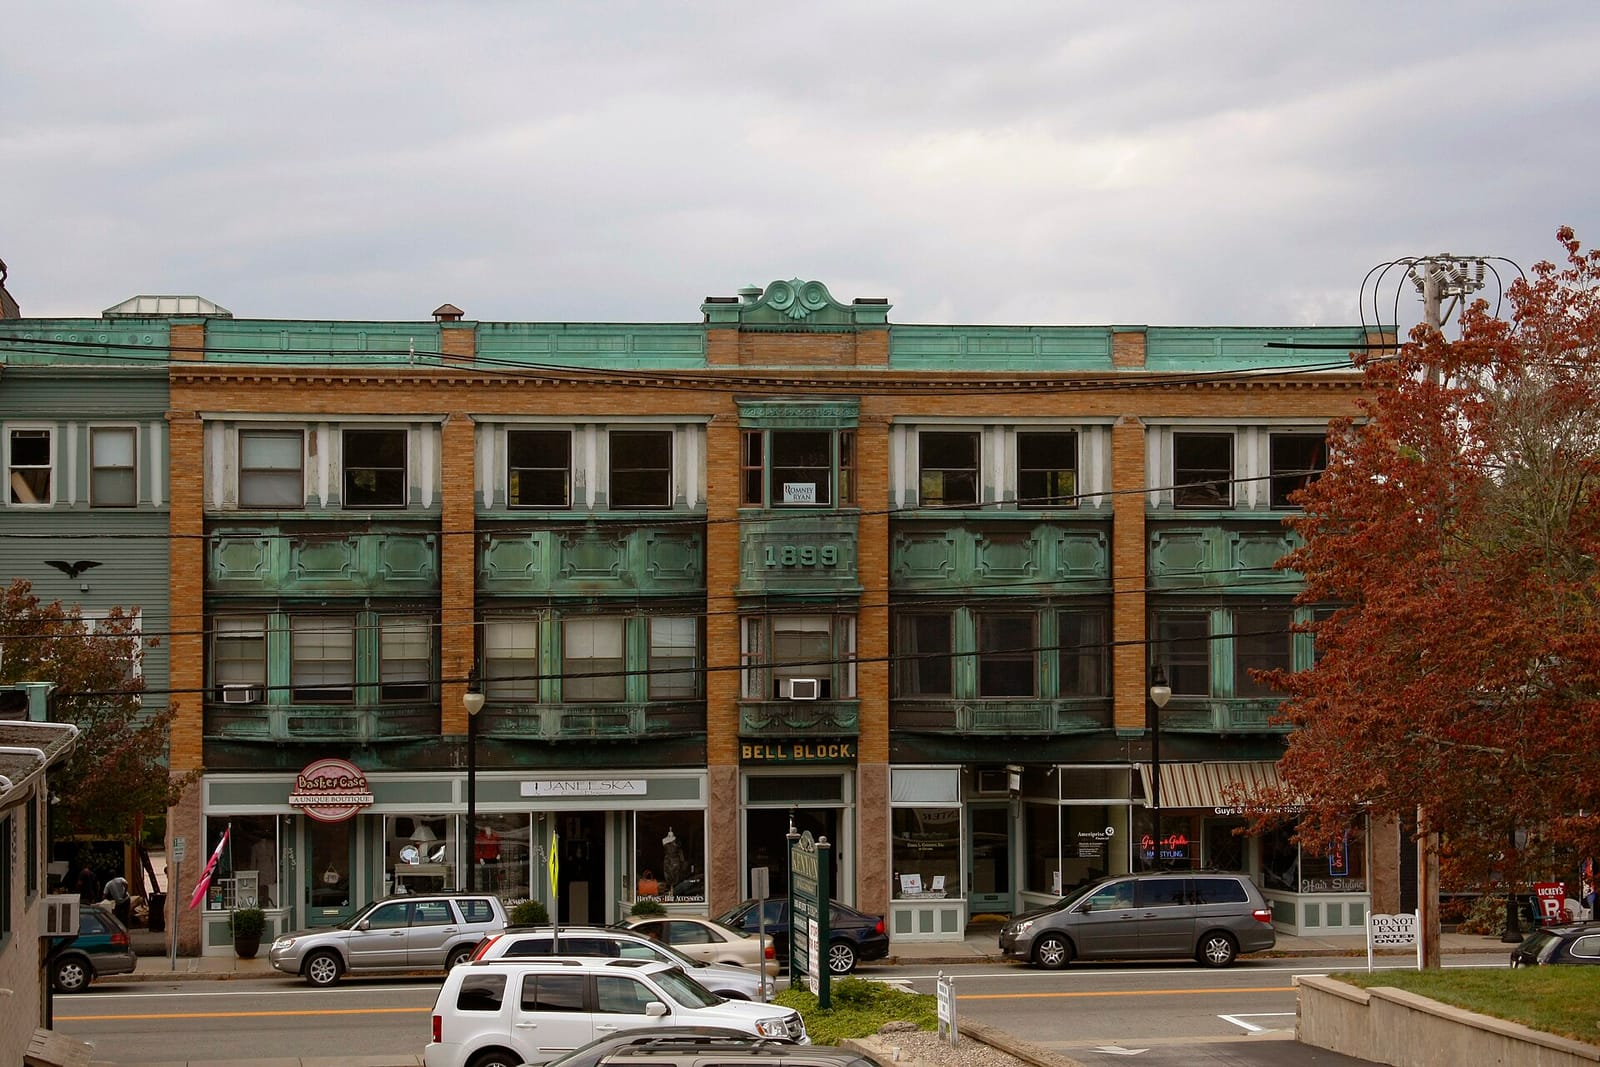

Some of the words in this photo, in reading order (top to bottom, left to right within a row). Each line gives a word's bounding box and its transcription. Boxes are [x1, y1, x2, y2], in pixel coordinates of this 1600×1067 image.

[785, 484, 814, 496] ROMNEY
[765, 545, 838, 567] 1899
[742, 745, 787, 759] BELL
[298, 775, 339, 790] Basket
[339, 775, 366, 788] Case
[300, 796, 330, 804] UNIQUE
[331, 795, 370, 803] BOUTIQUE
[1214, 807, 1235, 816] Guys
[1078, 831, 1105, 839] Ameriprise
[1302, 879, 1328, 893] Hair
[1392, 917, 1415, 925] NOT
[1378, 925, 1411, 933] EXIT
